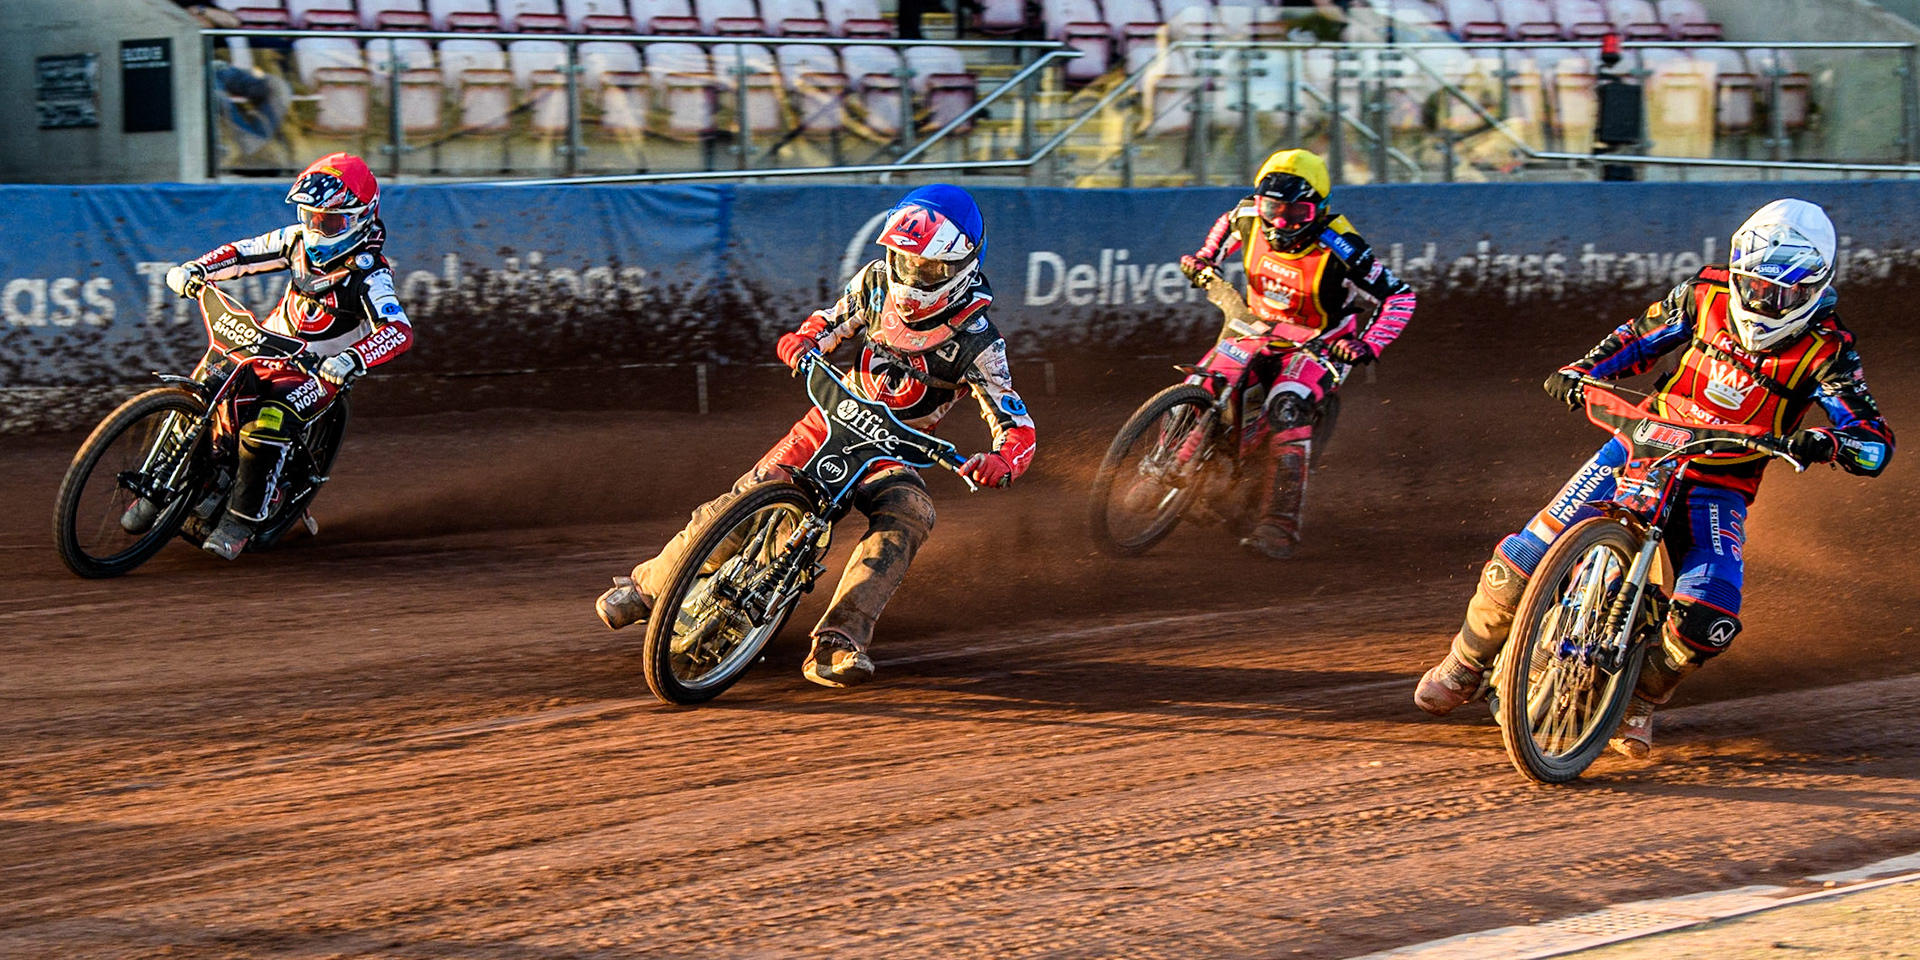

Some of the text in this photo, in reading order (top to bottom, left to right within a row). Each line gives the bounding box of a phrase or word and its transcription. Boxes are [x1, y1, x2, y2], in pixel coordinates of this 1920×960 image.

[401, 253, 648, 317] olutions
[1263, 260, 1299, 280] KENT
[212, 320, 260, 355] SHOCKS
[218, 312, 268, 344] HAGON
[364, 331, 407, 364] SHOCKS
[821, 460, 843, 477] ATPI
[1549, 462, 1601, 516] INTUITIVE
[1557, 464, 1613, 523] TRAINING
